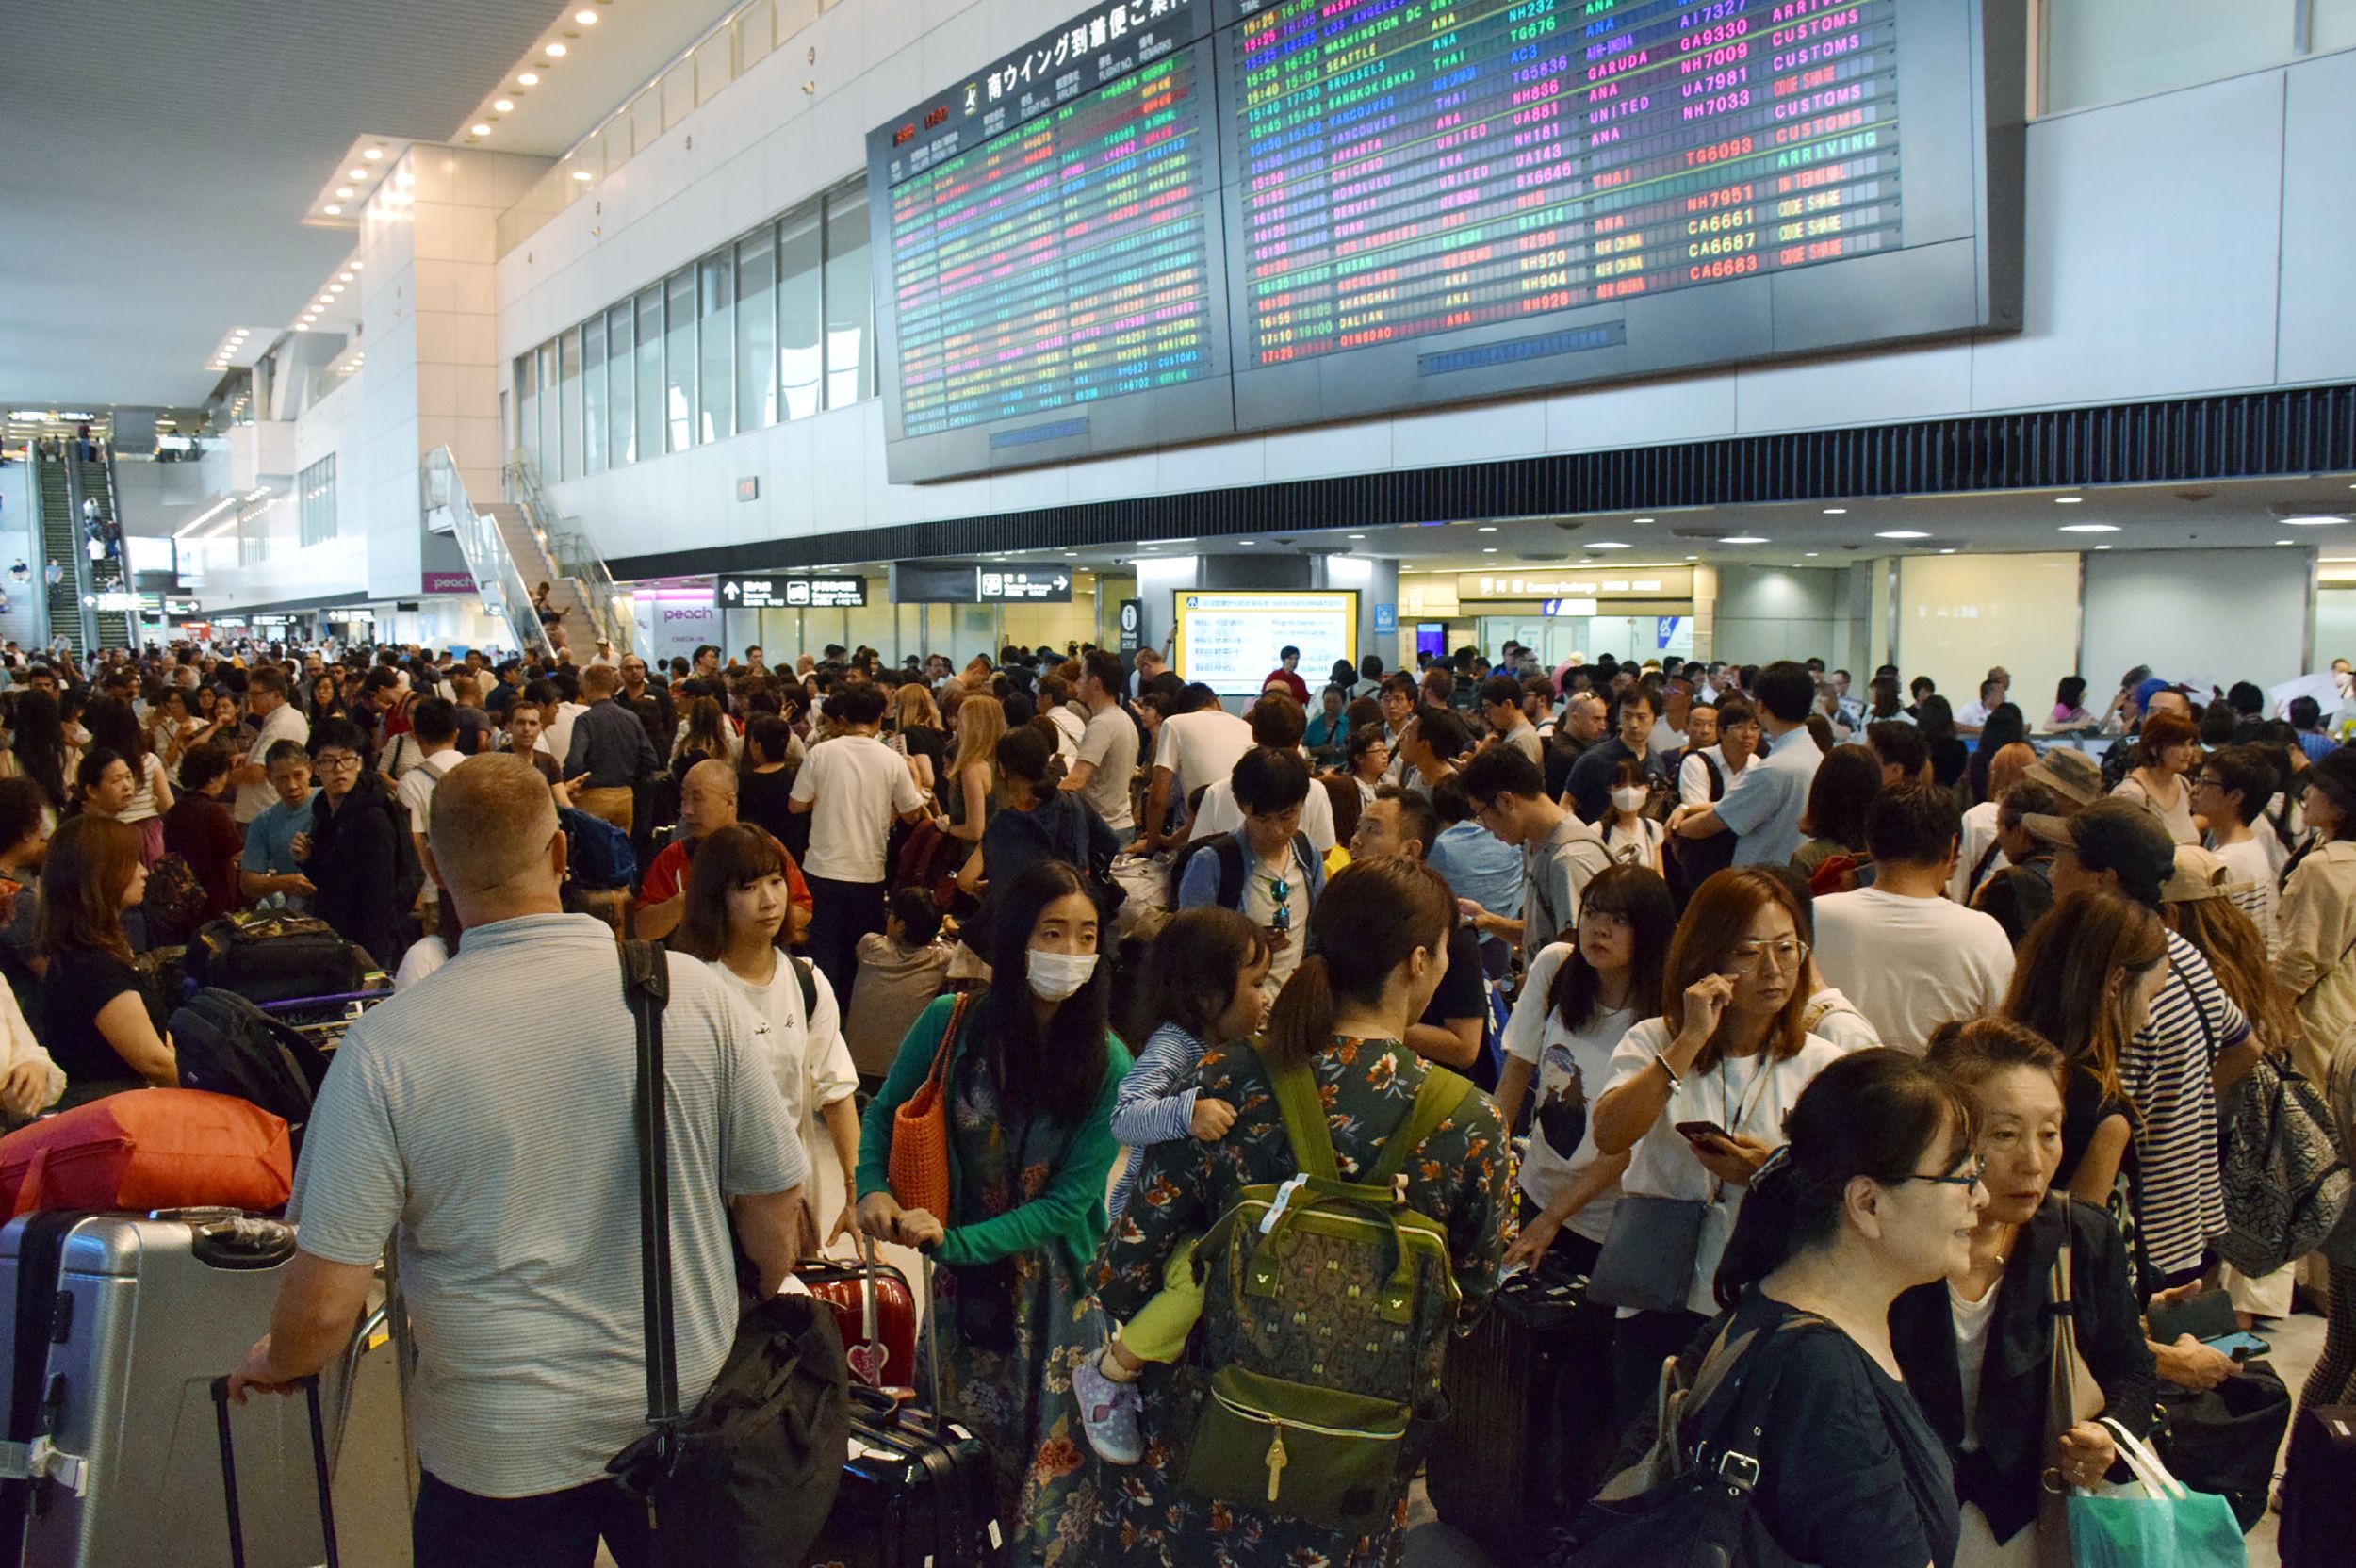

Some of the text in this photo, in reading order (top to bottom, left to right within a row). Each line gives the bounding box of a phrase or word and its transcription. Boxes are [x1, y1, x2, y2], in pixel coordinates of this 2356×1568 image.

[1241, 2, 1260, 13] TIME
[1243, 0, 1315, 36] 15:25 16:05
[1244, 29, 1276, 53] 15:25
[1246, 7, 1420, 88] 15:25 16:27 WASHINGTON DC
[1324, 20, 1343, 37] LOS
[988, 0, 1187, 102] 南ウイング到着便ご案
[1099, 61, 1121, 81] FLIGHT
[1247, 13, 1455, 105] 15:40 15:04 SEATTLE ANA
[1248, 0, 1553, 122] 15:40 17:30 BRUSSELS ANA NH232
[1249, 118, 1281, 139] 15:45
[1434, 50, 1465, 72] THAI
[1511, 17, 1554, 44] TG676
[1585, 0, 1612, 17] ANA
[1330, 96, 1394, 128] VANCOUVER
[1511, 45, 1536, 65] AC3
[1586, 17, 1613, 39] ANA
[1331, 115, 1395, 146] VANCOUVER
[1436, 90, 1467, 111] THAI
[1513, 56, 1566, 86] TG5836
[1586, 33, 1632, 61] AIR-INDIA
[1252, 18, 1747, 190] 15:50 JAKARTA ANA NH836 GARUDA GA9330
[1333, 158, 1382, 183] CHICAGO
[1438, 124, 1486, 150] UNITED
[1514, 102, 1559, 126] UA881
[1589, 83, 1617, 104] ANA
[1681, 41, 1747, 76] NH7009
[1772, 8, 1858, 47] CUSTOMS
[1333, 174, 1390, 201] HONOLULU
[1439, 153, 1462, 170] ANA
[1515, 122, 1560, 147] NH181
[1590, 96, 1649, 125] UNITED
[1682, 66, 1747, 99] UA7981
[1774, 32, 1859, 72] CUSTOMS
[1146, 154, 1186, 178] CUSTOMS
[1148, 170, 1186, 194] ARRIVED
[1254, 223, 1286, 242] 16:25
[1333, 198, 1376, 220] DENVER
[1440, 165, 1488, 189] UNITED
[1516, 144, 1561, 168] UA143
[1591, 127, 1619, 147] ANA
[1683, 90, 1750, 122] NH7033
[1255, 241, 1287, 259] 16:30
[1334, 220, 1362, 237] GUAM
[1775, 83, 1861, 121] CUSTOMS
[1336, 241, 1356, 255] LOS
[1594, 169, 1630, 189] THAI
[1687, 138, 1752, 168] TG6093
[1776, 108, 1862, 144] CUSTOMS
[1595, 215, 1623, 233] ANA
[1688, 185, 1753, 214] NH7951
[1257, 276, 1289, 294] 16:35
[1337, 255, 1371, 274] BUSAN
[1778, 130, 1876, 168] ARRIVING
[1153, 269, 1192, 289] CUSTOMS
[1155, 302, 1194, 320] ARRIVED
[1259, 311, 1291, 328] 16:55
[1338, 288, 1396, 310] SHANGHAI
[1445, 271, 1467, 287] ANA
[1521, 250, 1565, 270] NH920
[1688, 208, 1753, 237] CA6661
[1260, 329, 1292, 345] 17:10
[1299, 320, 1333, 337] 19:00
[1339, 310, 1382, 328] DALIAN
[1446, 291, 1468, 306] ANA
[1522, 270, 1566, 291] NH904
[1689, 232, 1755, 259] CA6687
[1261, 346, 1293, 363] 17:25
[1340, 327, 1390, 347] QINGDAO
[1447, 311, 1469, 326] ANA
[1523, 291, 1568, 312] NH928
[1690, 254, 1757, 282] CA6683
[1156, 318, 1195, 336] CUSTOMS
[1157, 334, 1196, 352] ARRIVED
[1157, 351, 1197, 368] CUSTOMS
[433, 576, 474, 590] peach
[663, 606, 713, 623] peach
